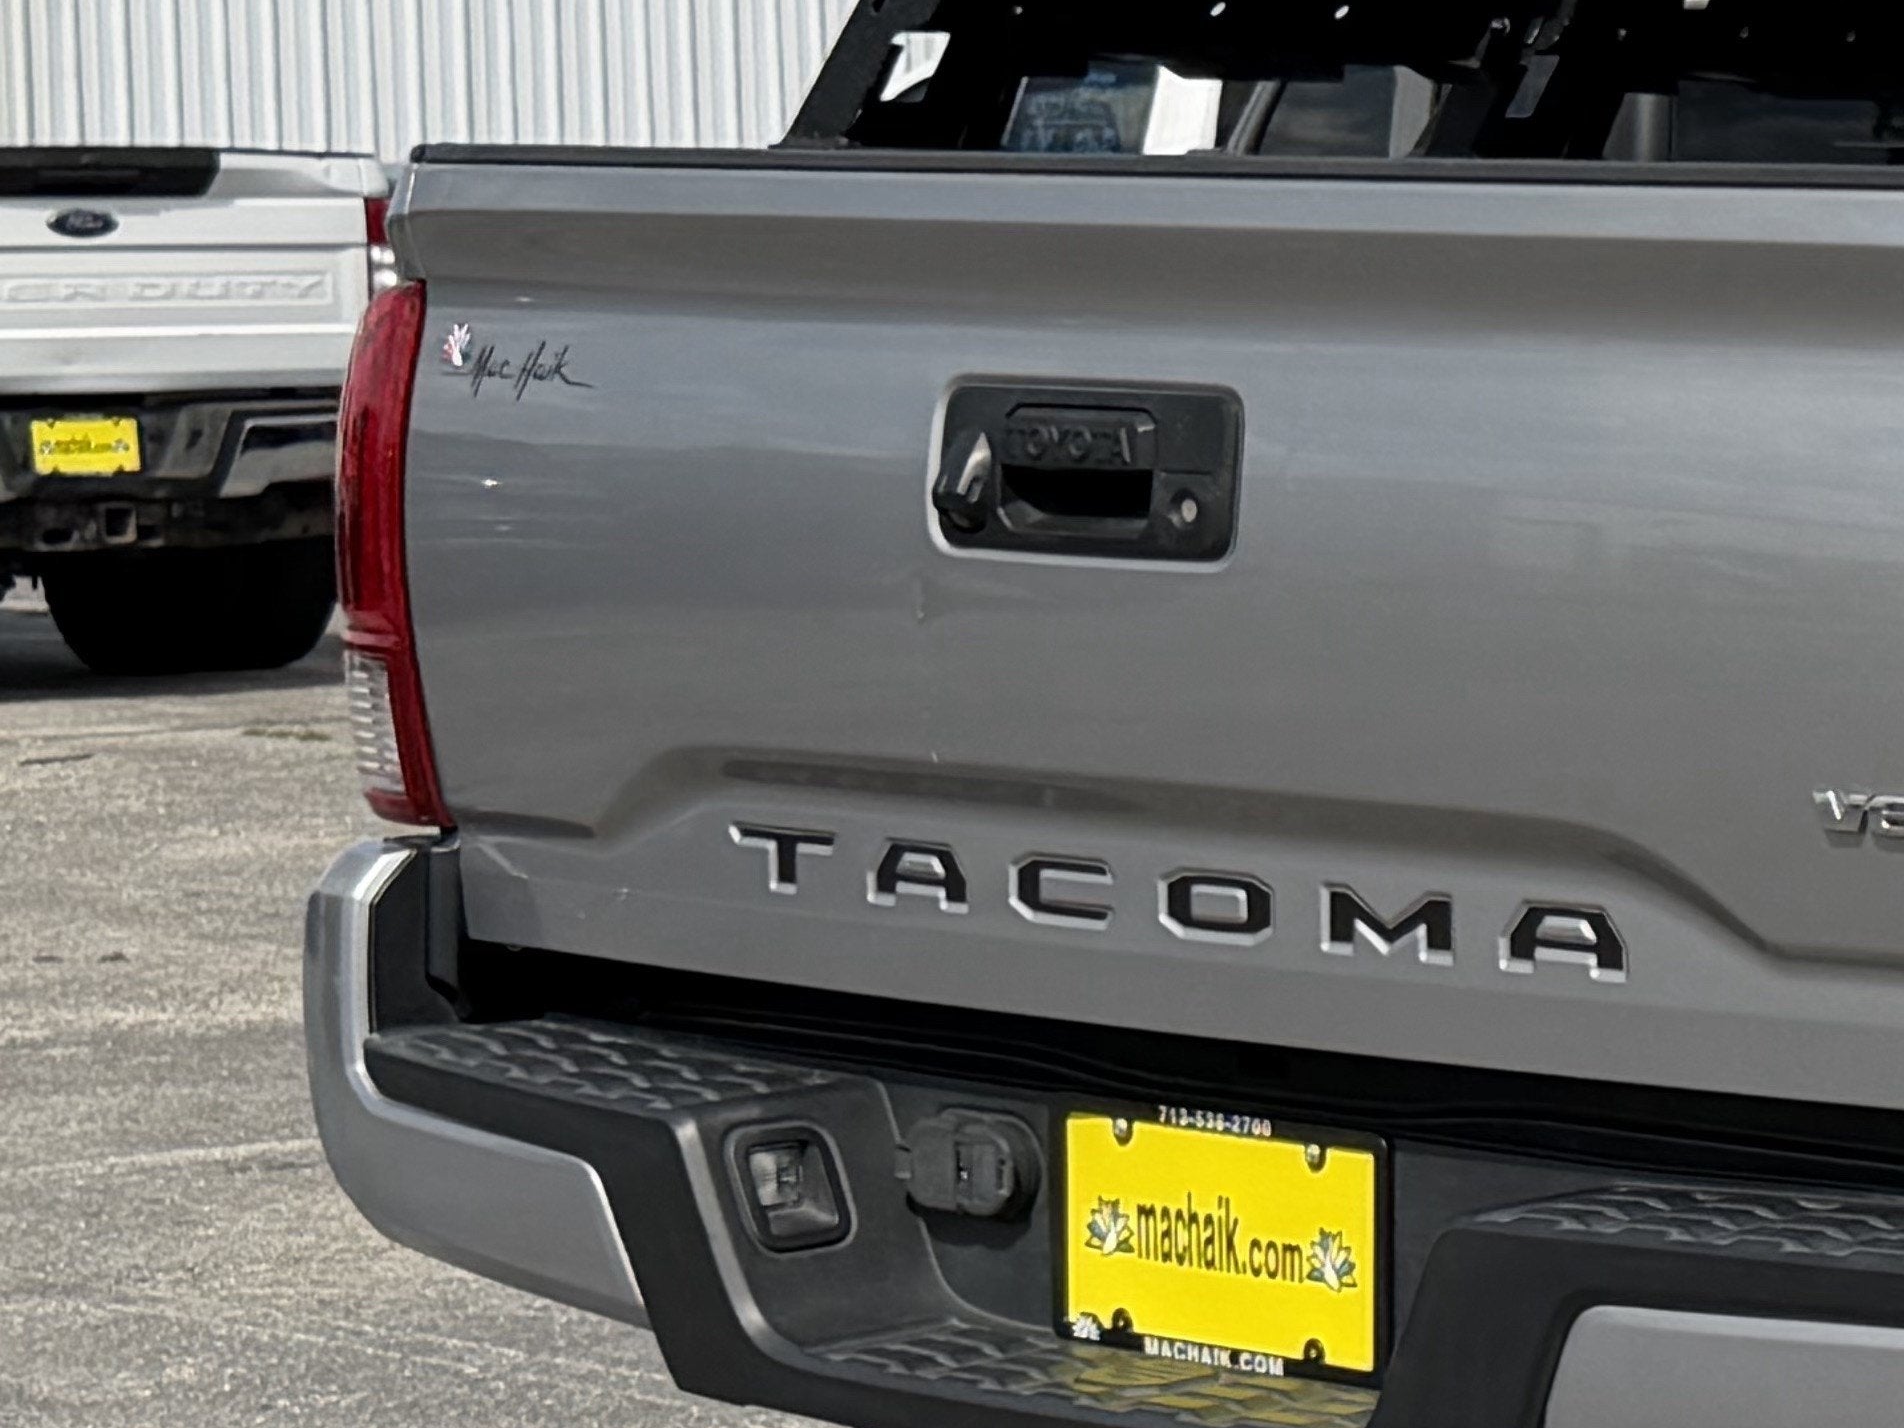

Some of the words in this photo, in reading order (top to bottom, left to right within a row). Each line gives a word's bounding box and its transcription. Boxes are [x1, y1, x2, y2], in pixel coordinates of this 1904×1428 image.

[127, 274, 327, 302] DUTY
[728, 819, 1630, 982] TACOMA
[1136, 1191, 1304, 1283] machaik.com
[1144, 1335, 1285, 1377] MACHAIK.COM
